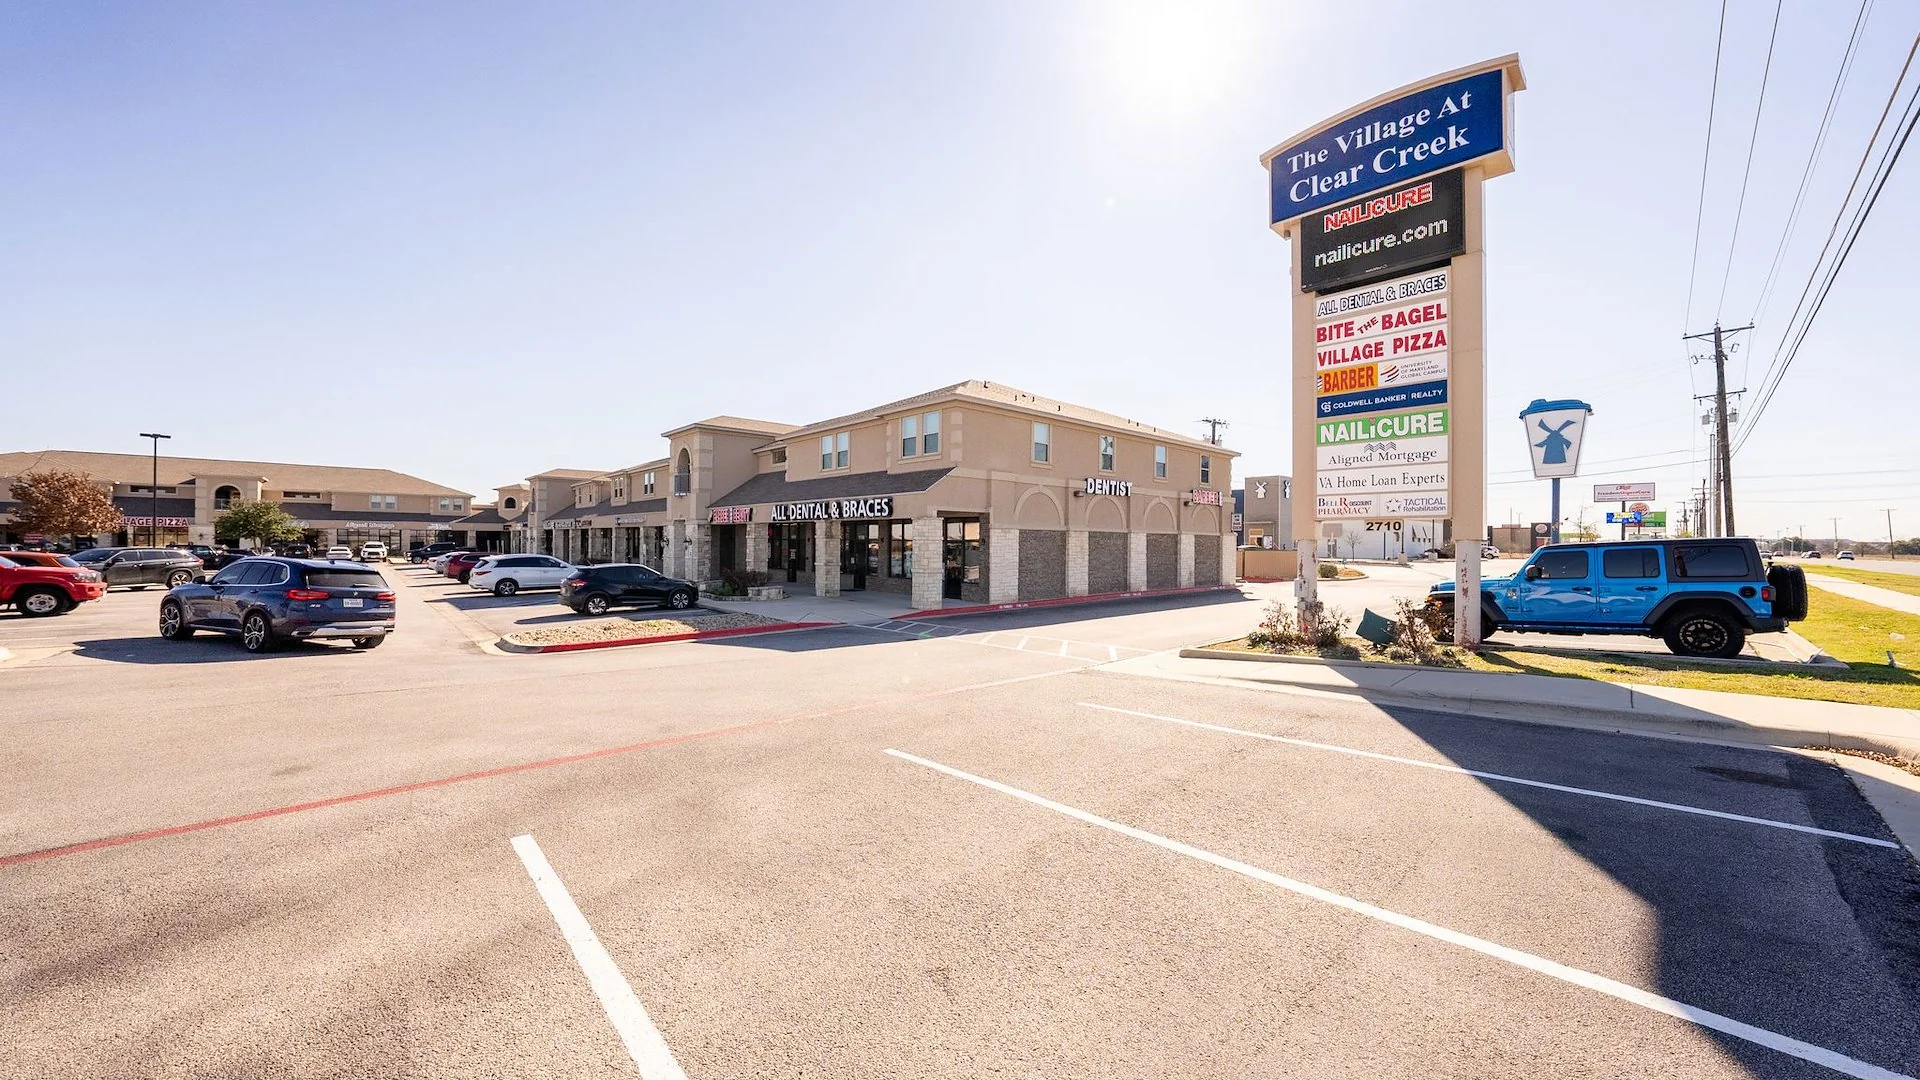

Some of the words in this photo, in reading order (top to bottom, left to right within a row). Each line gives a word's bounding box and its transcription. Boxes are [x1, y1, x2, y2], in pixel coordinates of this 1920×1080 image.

[1287, 148, 1329, 175] The
[1335, 108, 1431, 154] Village
[1436, 90, 1472, 119] At
[1289, 163, 1364, 203] Clear
[1372, 124, 1470, 174] Creek
[1314, 218, 1448, 268] nailicure.com
[1318, 299, 1338, 316] ALL
[1340, 289, 1384, 312] DENTAL
[1386, 287, 1396, 301] &
[1399, 274, 1447, 299] BRACES
[1316, 320, 1355, 343] BITE
[1357, 316, 1379, 335] THE
[1381, 303, 1447, 330] BAGEL
[1317, 341, 1384, 367] VILLAGE
[1393, 329, 1447, 355] PIZZA
[1400, 360, 1433, 369] UNIVERSITY
[1400, 372, 1422, 380] GLOBAL
[1423, 368, 1447, 376] CAMPUS
[1409, 364, 1439, 373] MARYLAND
[1323, 365, 1375, 393] BARBER
[1333, 398, 1374, 410] COLDWELL
[1374, 393, 1407, 405] BANKER
[1411, 389, 1443, 400] REALTY
[1328, 452, 1373, 467] Aligned
[1378, 450, 1438, 463] Mortgage
[1086, 478, 1133, 497] DENTIST
[1319, 477, 1333, 489] VA
[1337, 476, 1367, 488] Home
[1371, 474, 1397, 487] Loan
[1402, 472, 1445, 487] Experts
[771, 504, 787, 521] ALL
[790, 502, 828, 520] DENTAL
[830, 502, 839, 518] &
[843, 498, 890, 518] BRACES
[1318, 506, 1370, 515] PHARMACY
[1404, 497, 1445, 506] TACTICAL
[121, 517, 153, 526] LAGE
[157, 518, 189, 527] PIZZA
[1366, 521, 1401, 532] 2710
